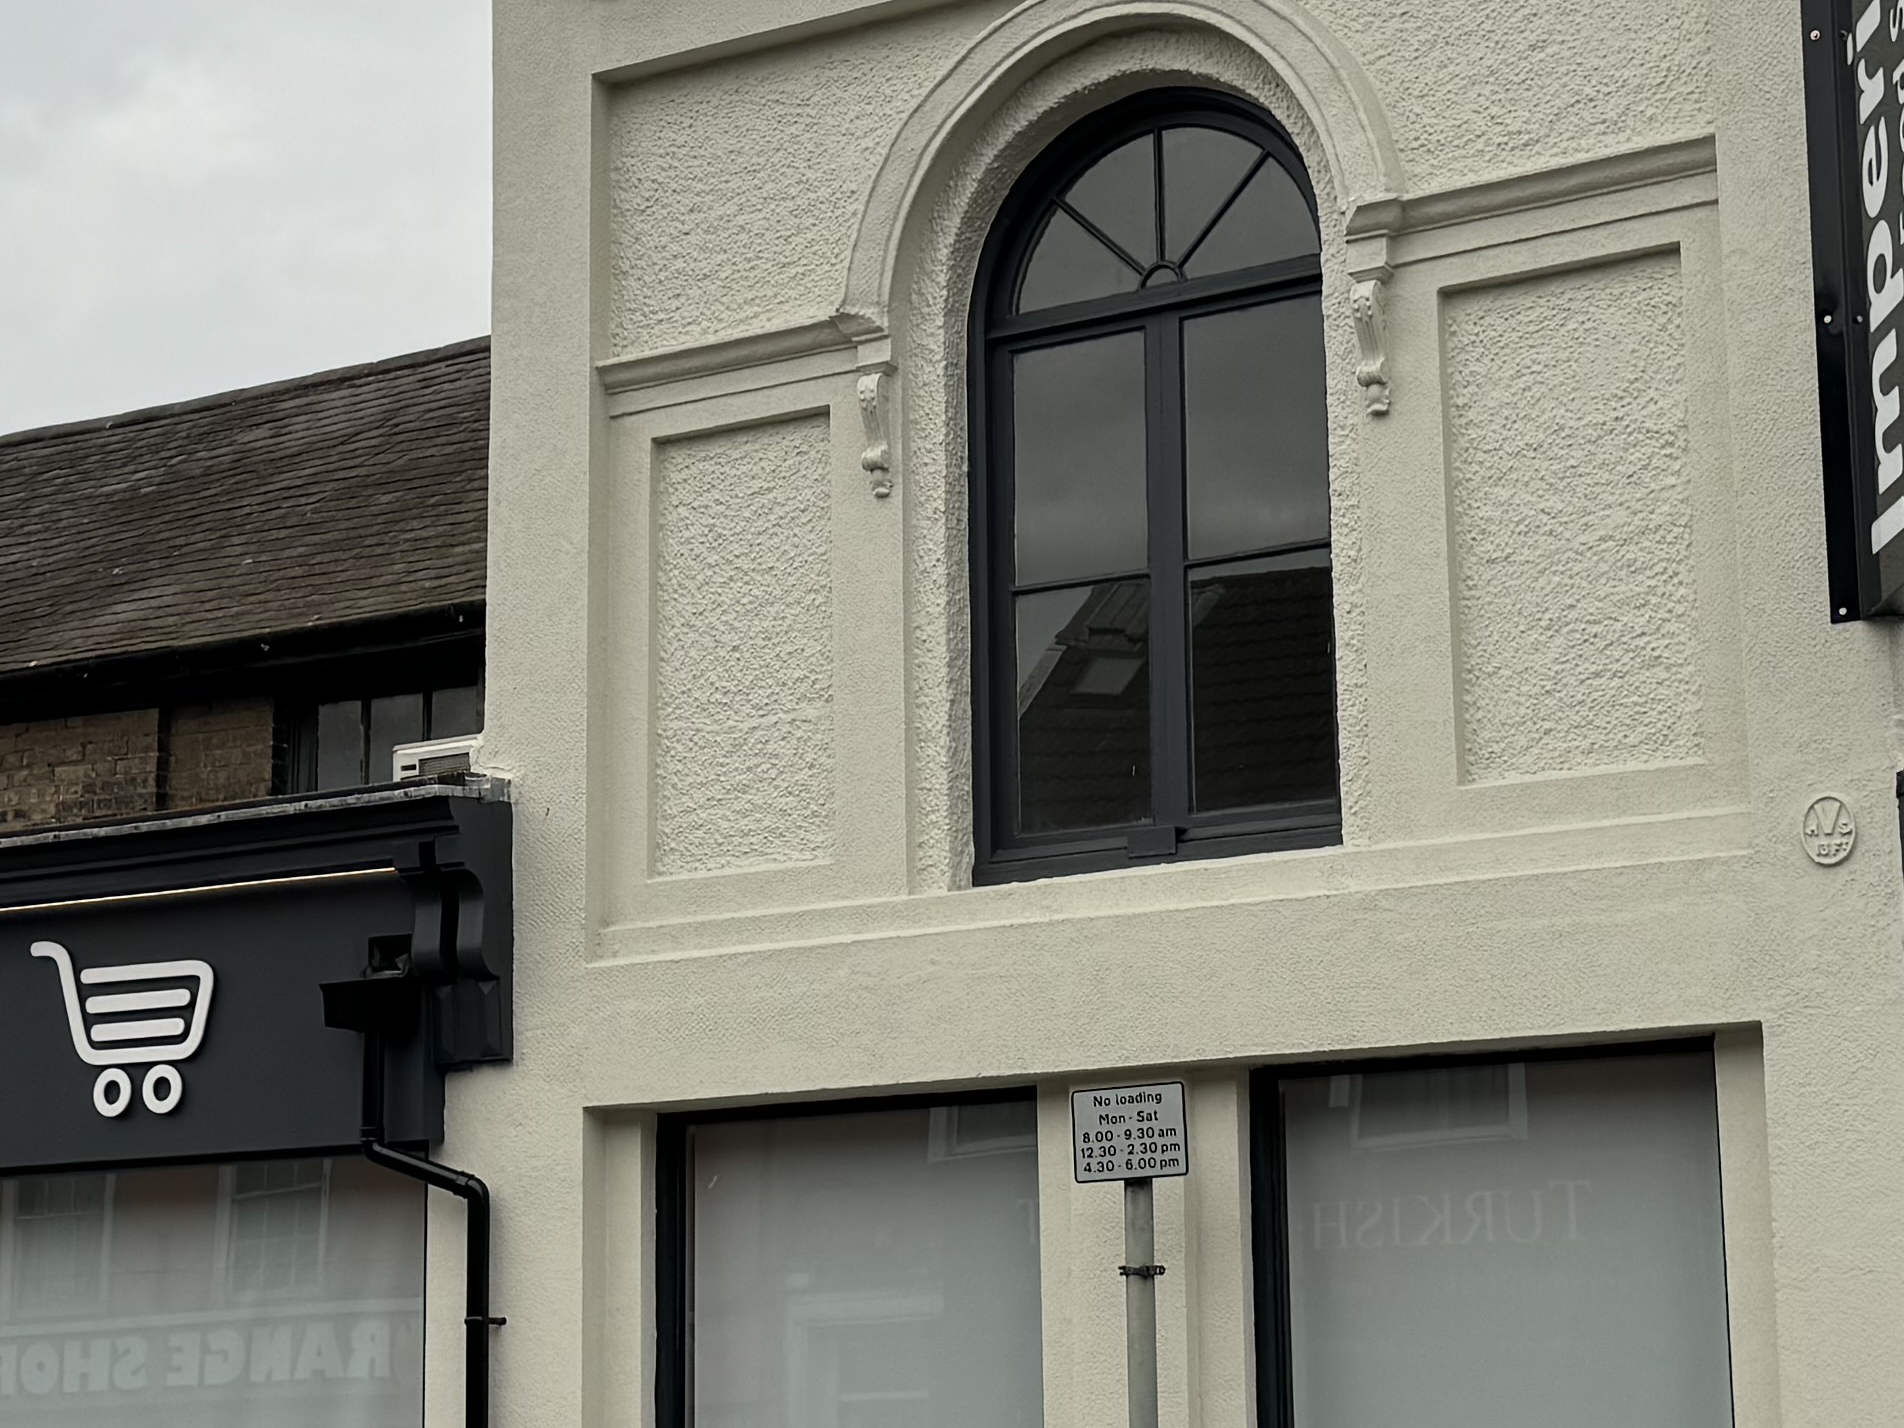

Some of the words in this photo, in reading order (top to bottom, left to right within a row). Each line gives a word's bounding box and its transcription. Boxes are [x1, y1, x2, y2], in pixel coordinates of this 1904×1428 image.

[1093, 1095, 1111, 1107] No
[1116, 1091, 1163, 1105] loading
[1099, 1113, 1126, 1125] Mon
[1136, 1110, 1159, 1122] Sat
[1082, 1130, 1114, 1143] 8.00
[1124, 1126, 1155, 1140] 9.30
[1158, 1127, 1177, 1138] am
[1080, 1145, 1117, 1159] 12.30
[1127, 1141, 1158, 1155] 2.30
[1160, 1142, 1181, 1154] pm
[1083, 1160, 1115, 1173] 4.30
[1125, 1157, 1157, 1170] 6.00
[1159, 1157, 1180, 1170] pm
